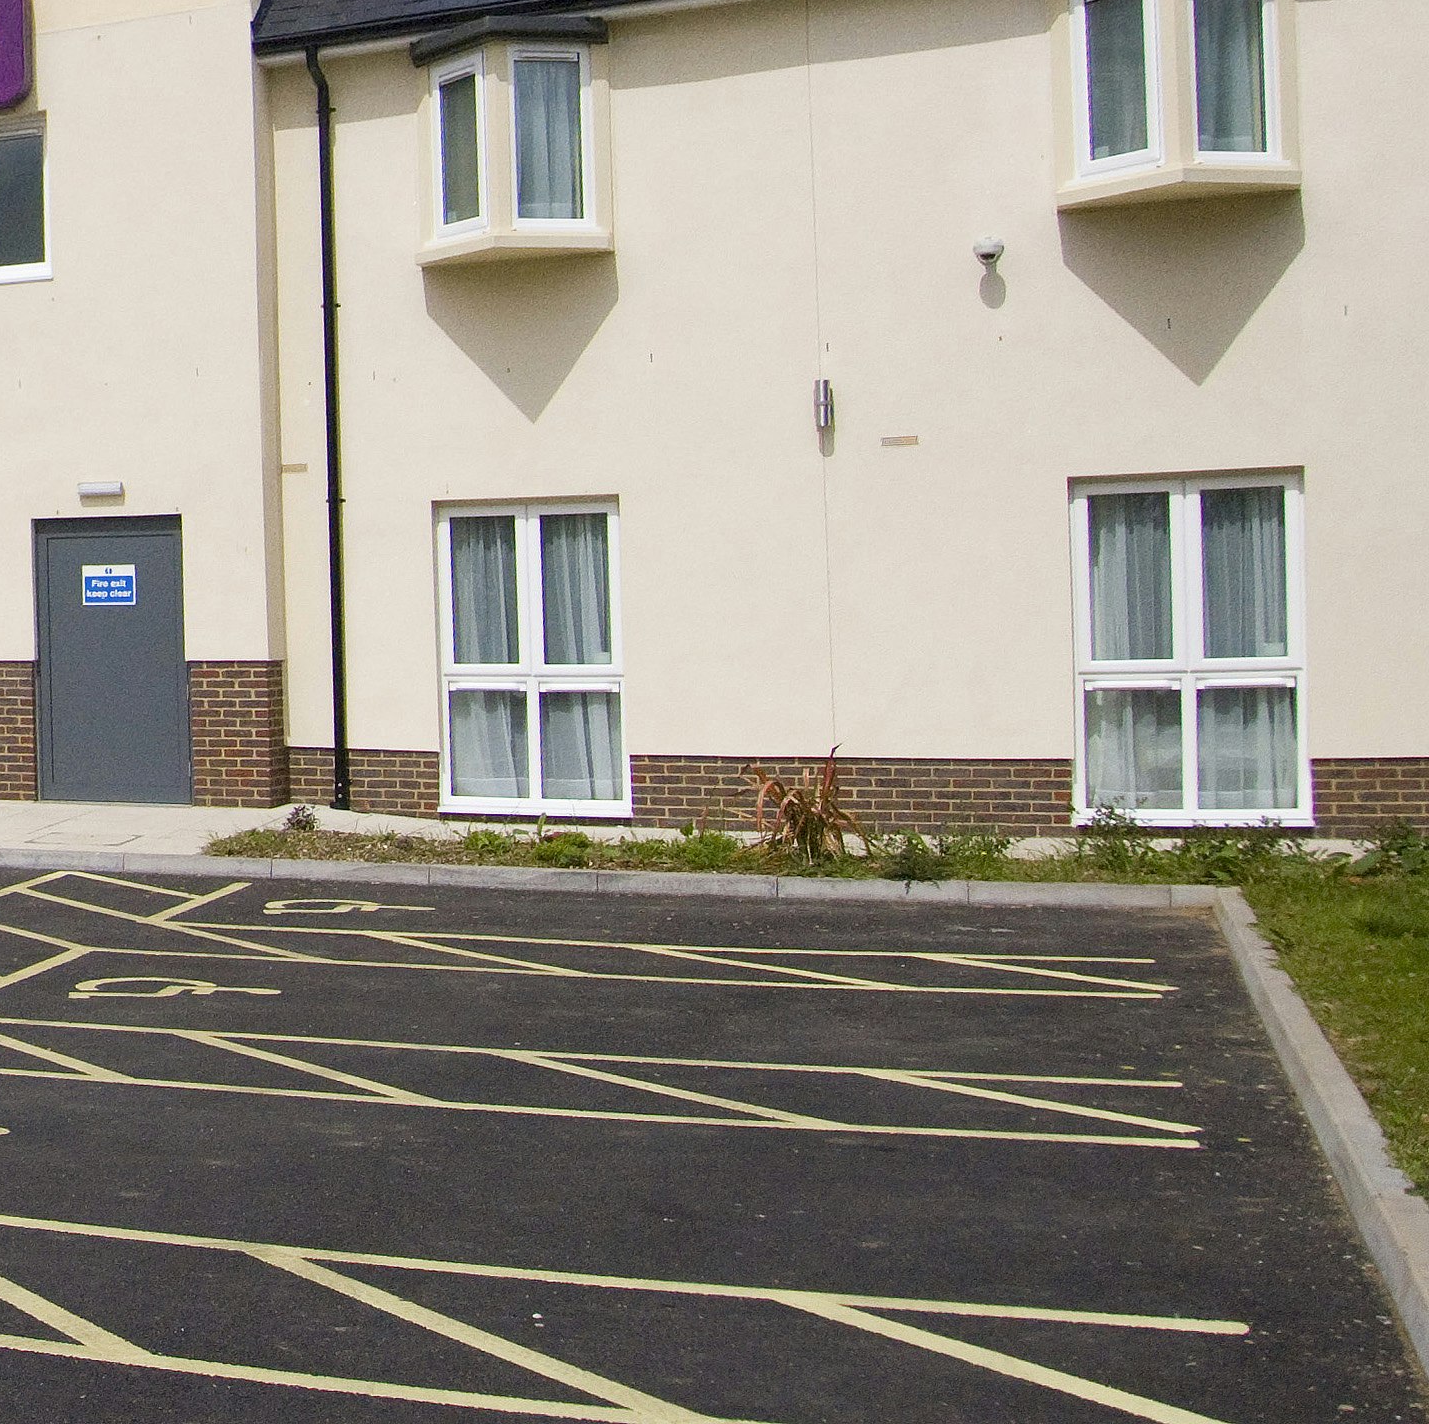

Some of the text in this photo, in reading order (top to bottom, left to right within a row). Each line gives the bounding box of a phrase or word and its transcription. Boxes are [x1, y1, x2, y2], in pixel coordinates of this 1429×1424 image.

[91, 579, 126, 588] Fire exit
[86, 589, 132, 600] keep clear
